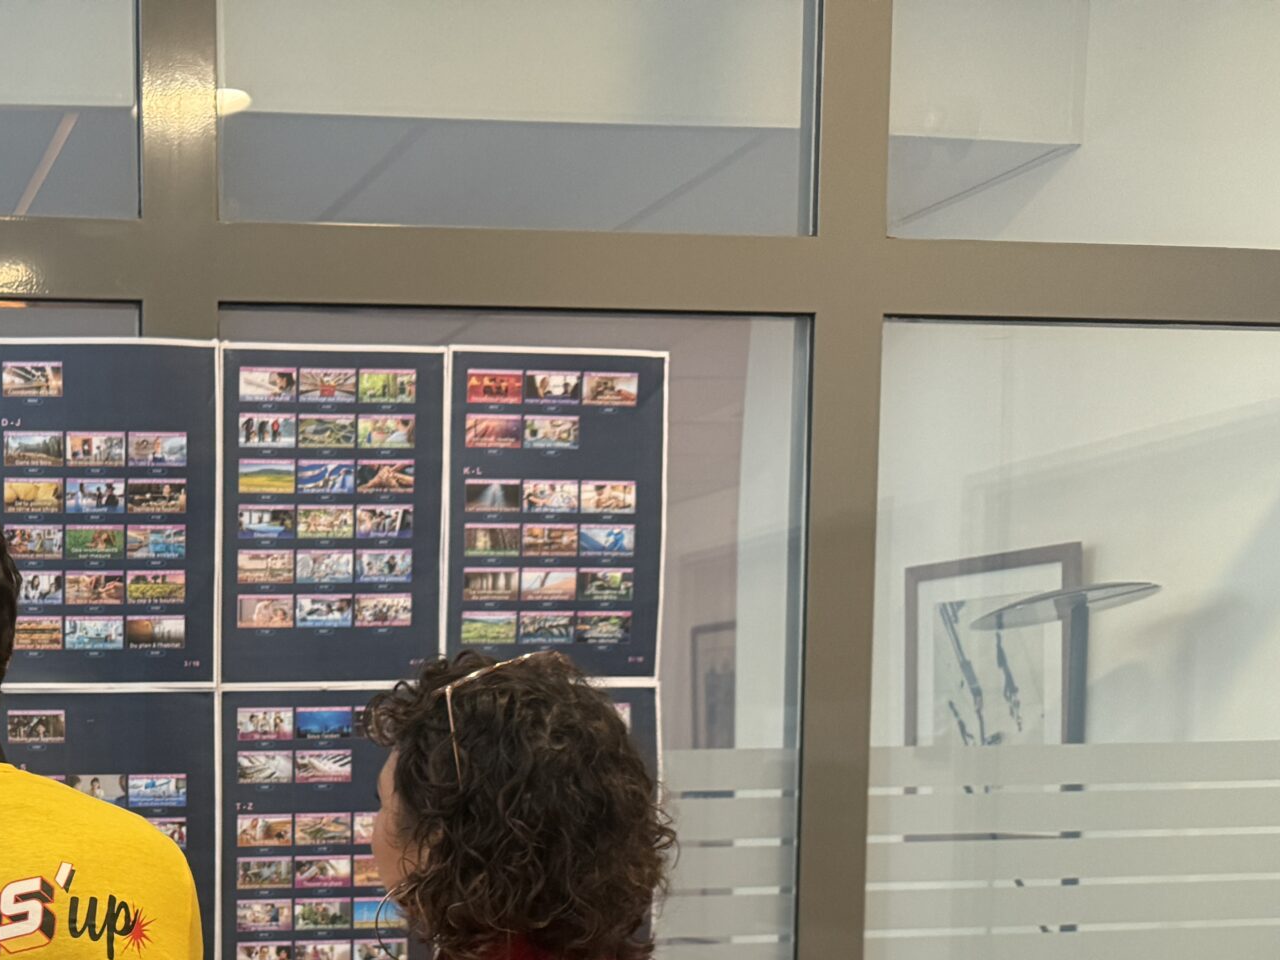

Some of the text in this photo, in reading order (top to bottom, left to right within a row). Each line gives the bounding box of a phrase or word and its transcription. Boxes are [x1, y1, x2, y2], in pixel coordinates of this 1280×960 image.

[1, 418, 8, 427] D
[16, 418, 21, 427] J
[463, 467, 470, 475] K
[476, 467, 482, 475] L
[236, 802, 241, 810] T
[247, 802, 253, 810] Z
